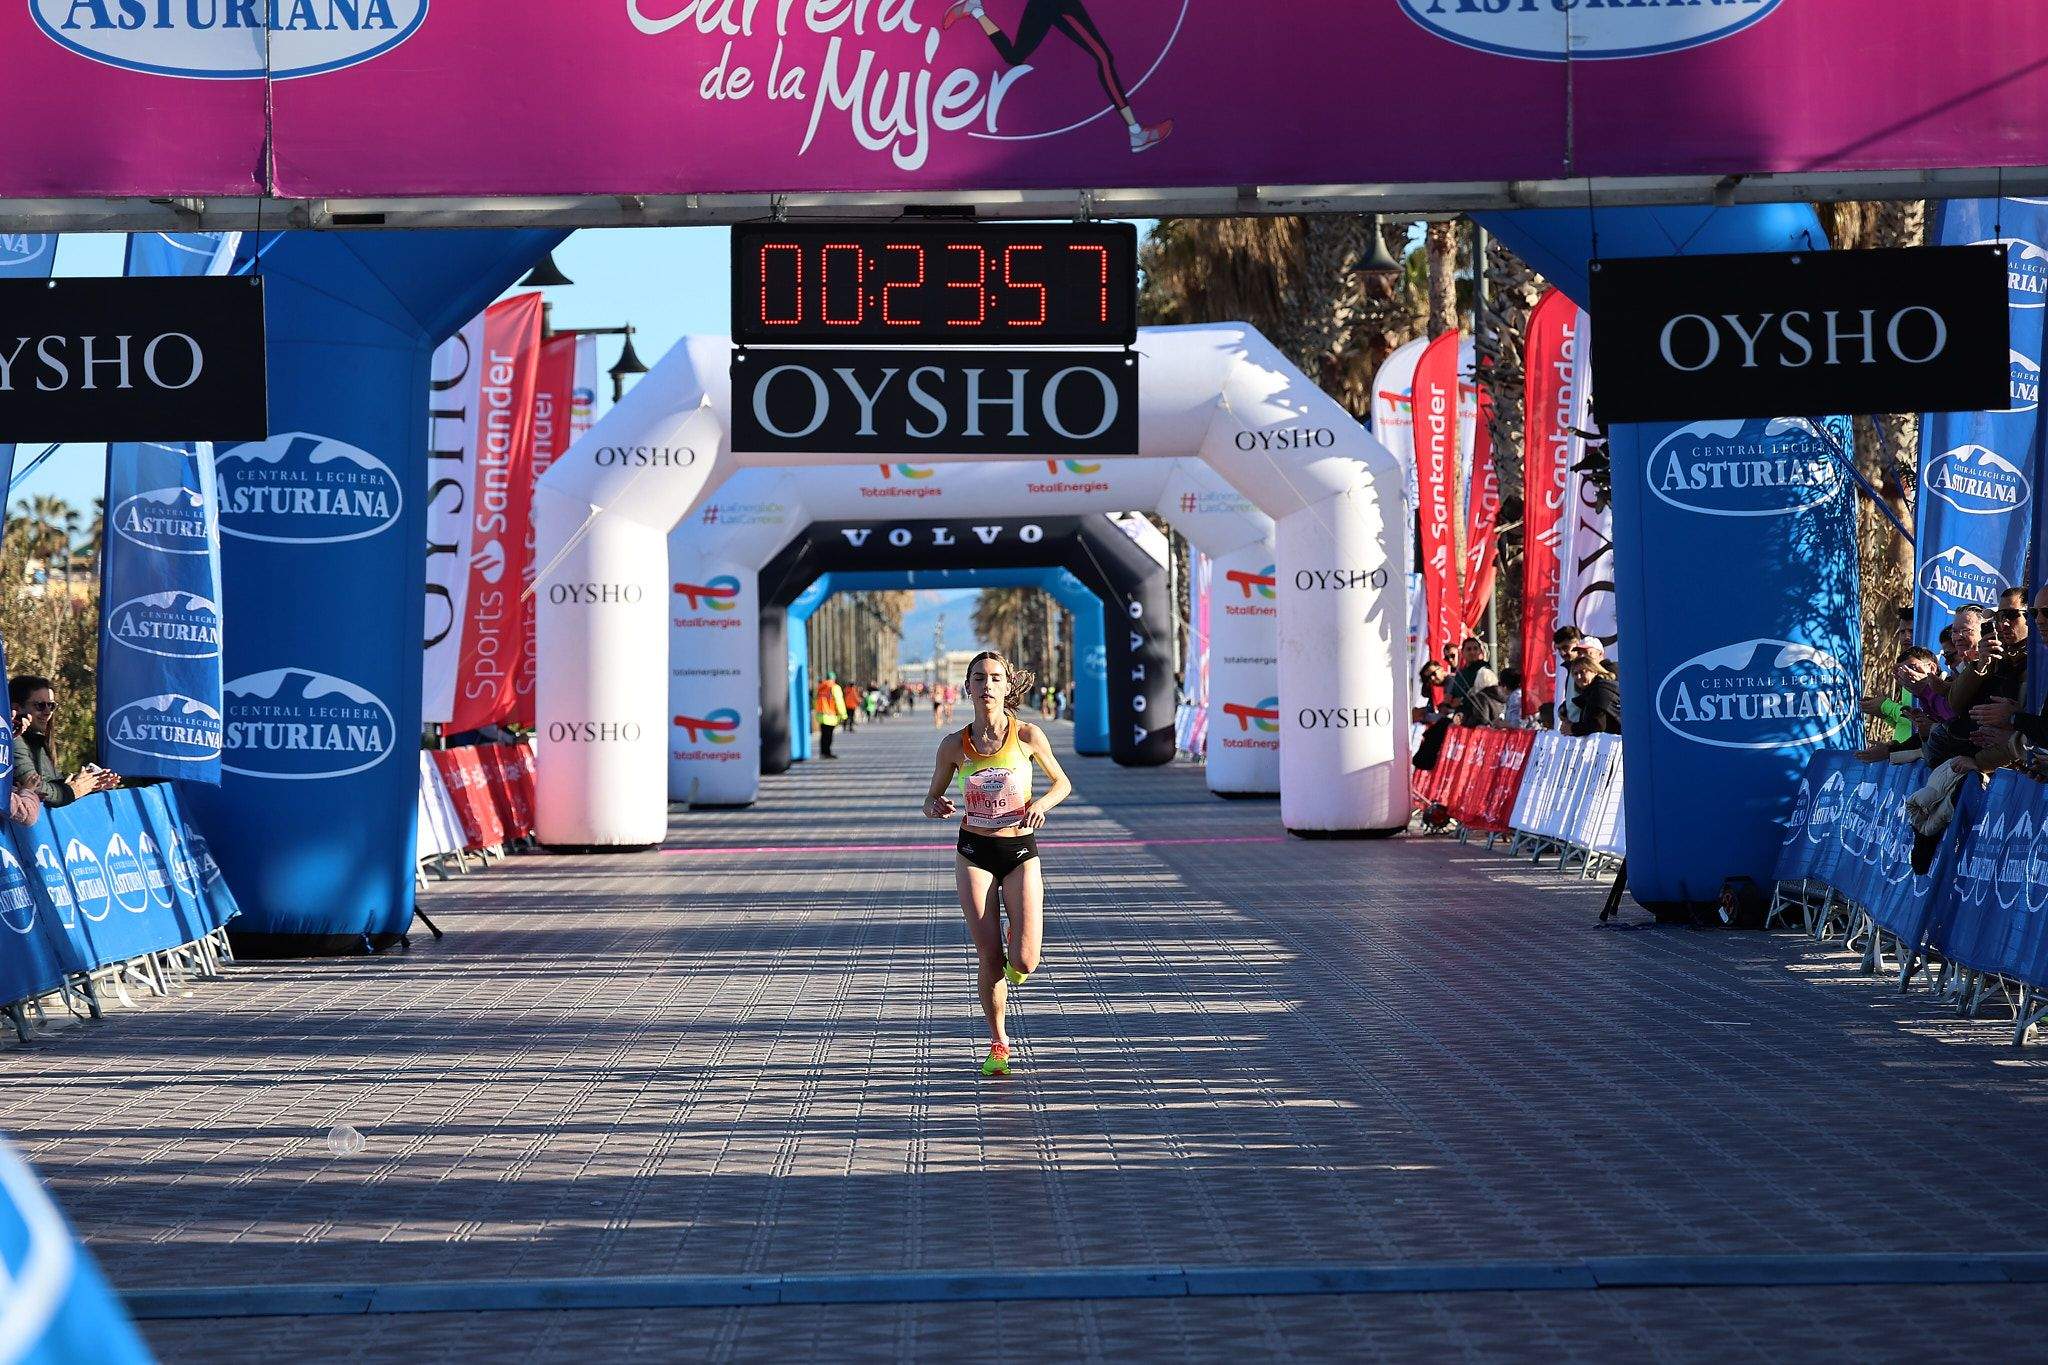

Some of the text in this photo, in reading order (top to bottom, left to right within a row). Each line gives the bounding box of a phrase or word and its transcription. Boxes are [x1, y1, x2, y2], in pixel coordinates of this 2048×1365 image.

[699, 27, 1034, 171] de la Mujer
[760, 243, 1107, 326] 00:23:57
[1659, 305, 1948, 372] OYSHO
[0, 332, 204, 391] YSHO
[2010, 369, 2040, 382] CHERA
[752, 364, 1120, 440] OYSHO
[475, 349, 515, 534] Santander
[1235, 428, 1336, 452] OYSHO
[1692, 444, 1765, 457] CENTRAL
[594, 445, 696, 467] OYSHO
[1428, 382, 1448, 540] Santander
[236, 470, 385, 485] CENTRAL LECHERA
[1027, 481, 1109, 494] TotalEnergies
[1978, 469, 2017, 484] LECHERA
[216, 472, 390, 518] ASTURIANA
[860, 486, 942, 499] TotalEnergies
[121, 506, 208, 538] ASTURIA
[842, 524, 1044, 547] VOLVO
[1295, 568, 1389, 591] OYSHO
[549, 583, 643, 605] OYSHO
[117, 611, 218, 644] ASTURIAN
[673, 618, 742, 629] TotalEnergies
[465, 590, 506, 699] Sports
[1223, 656, 1277, 665] totalenergie
[1127, 599, 1150, 746] VOLVO
[1701, 676, 1774, 689] CENTRAL
[230, 705, 378, 719] CENTRAL LECHERA
[1670, 681, 1846, 722] ASTURIANA
[1299, 706, 1392, 730] OYSHO
[222, 721, 383, 752] STURIANA
[548, 721, 641, 743] OYSHO
[673, 750, 742, 762] TotalEnergies
